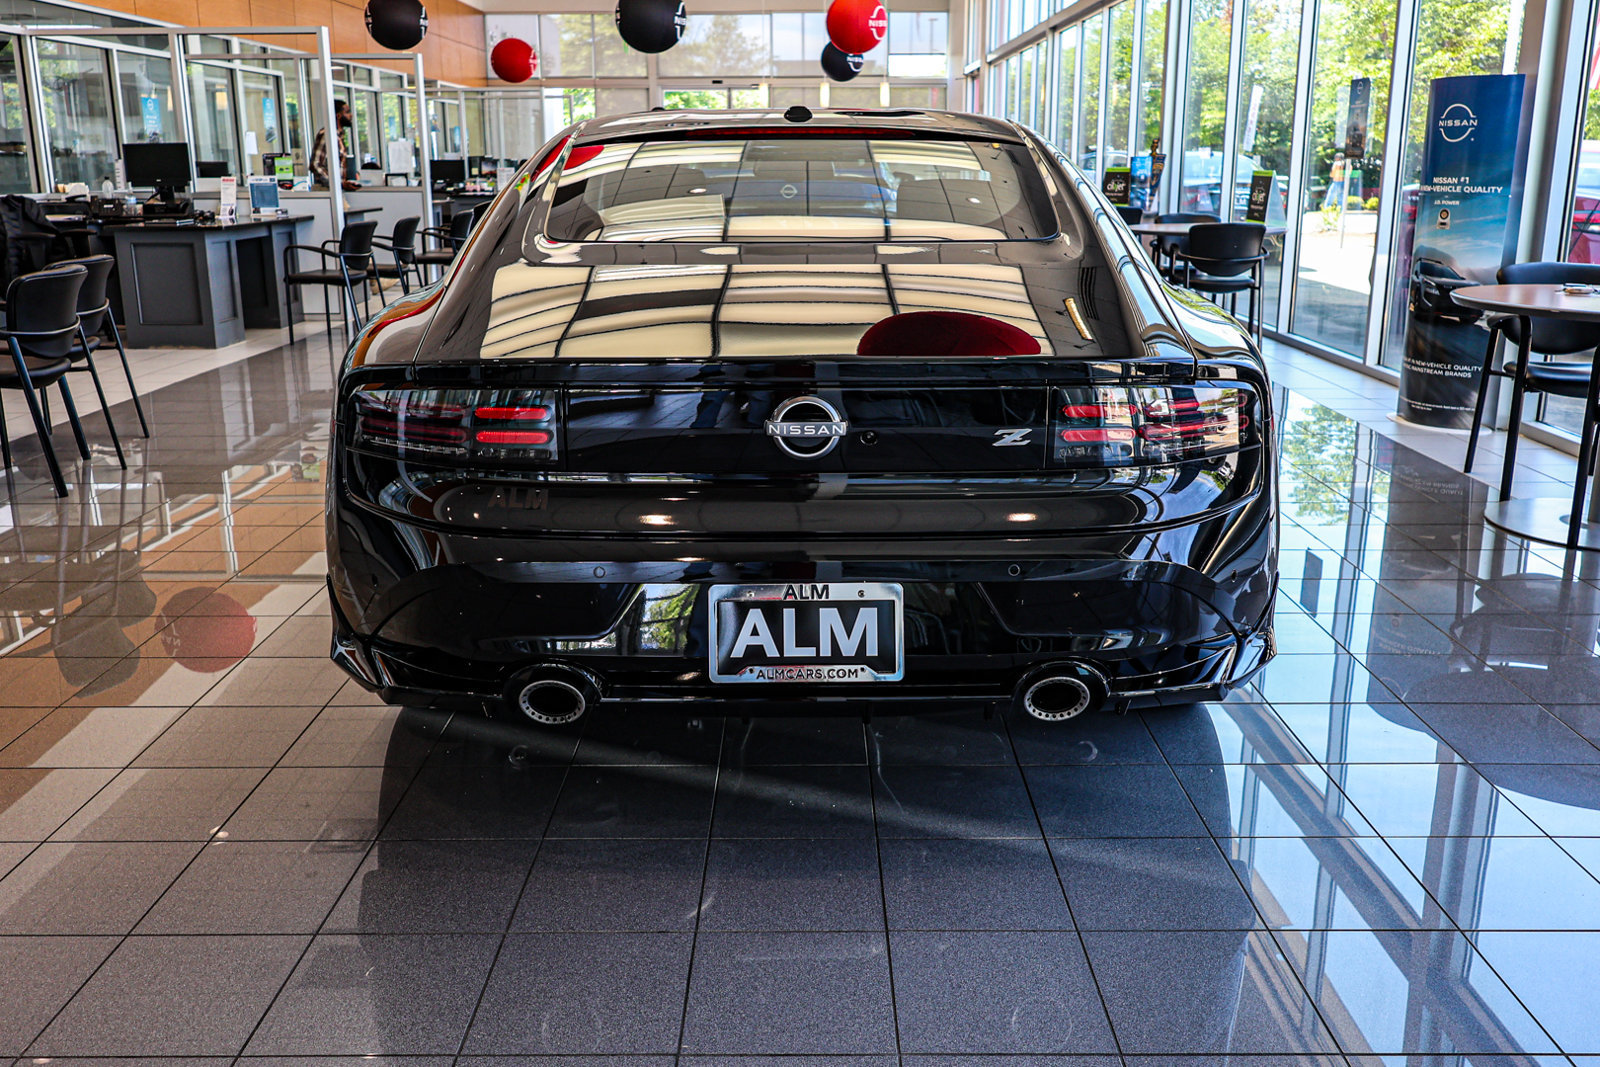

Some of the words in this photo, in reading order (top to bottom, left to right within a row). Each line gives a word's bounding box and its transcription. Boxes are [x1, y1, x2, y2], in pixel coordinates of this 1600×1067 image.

[1444, 370, 1472, 378] BRANDS
[1453, 364, 1482, 372] QUALITY
[768, 424, 844, 435] NISSAN
[992, 428, 1032, 446] Z
[782, 584, 830, 600] ALM
[730, 607, 879, 658] ALM
[756, 668, 858, 680] ALMCARS.COM
